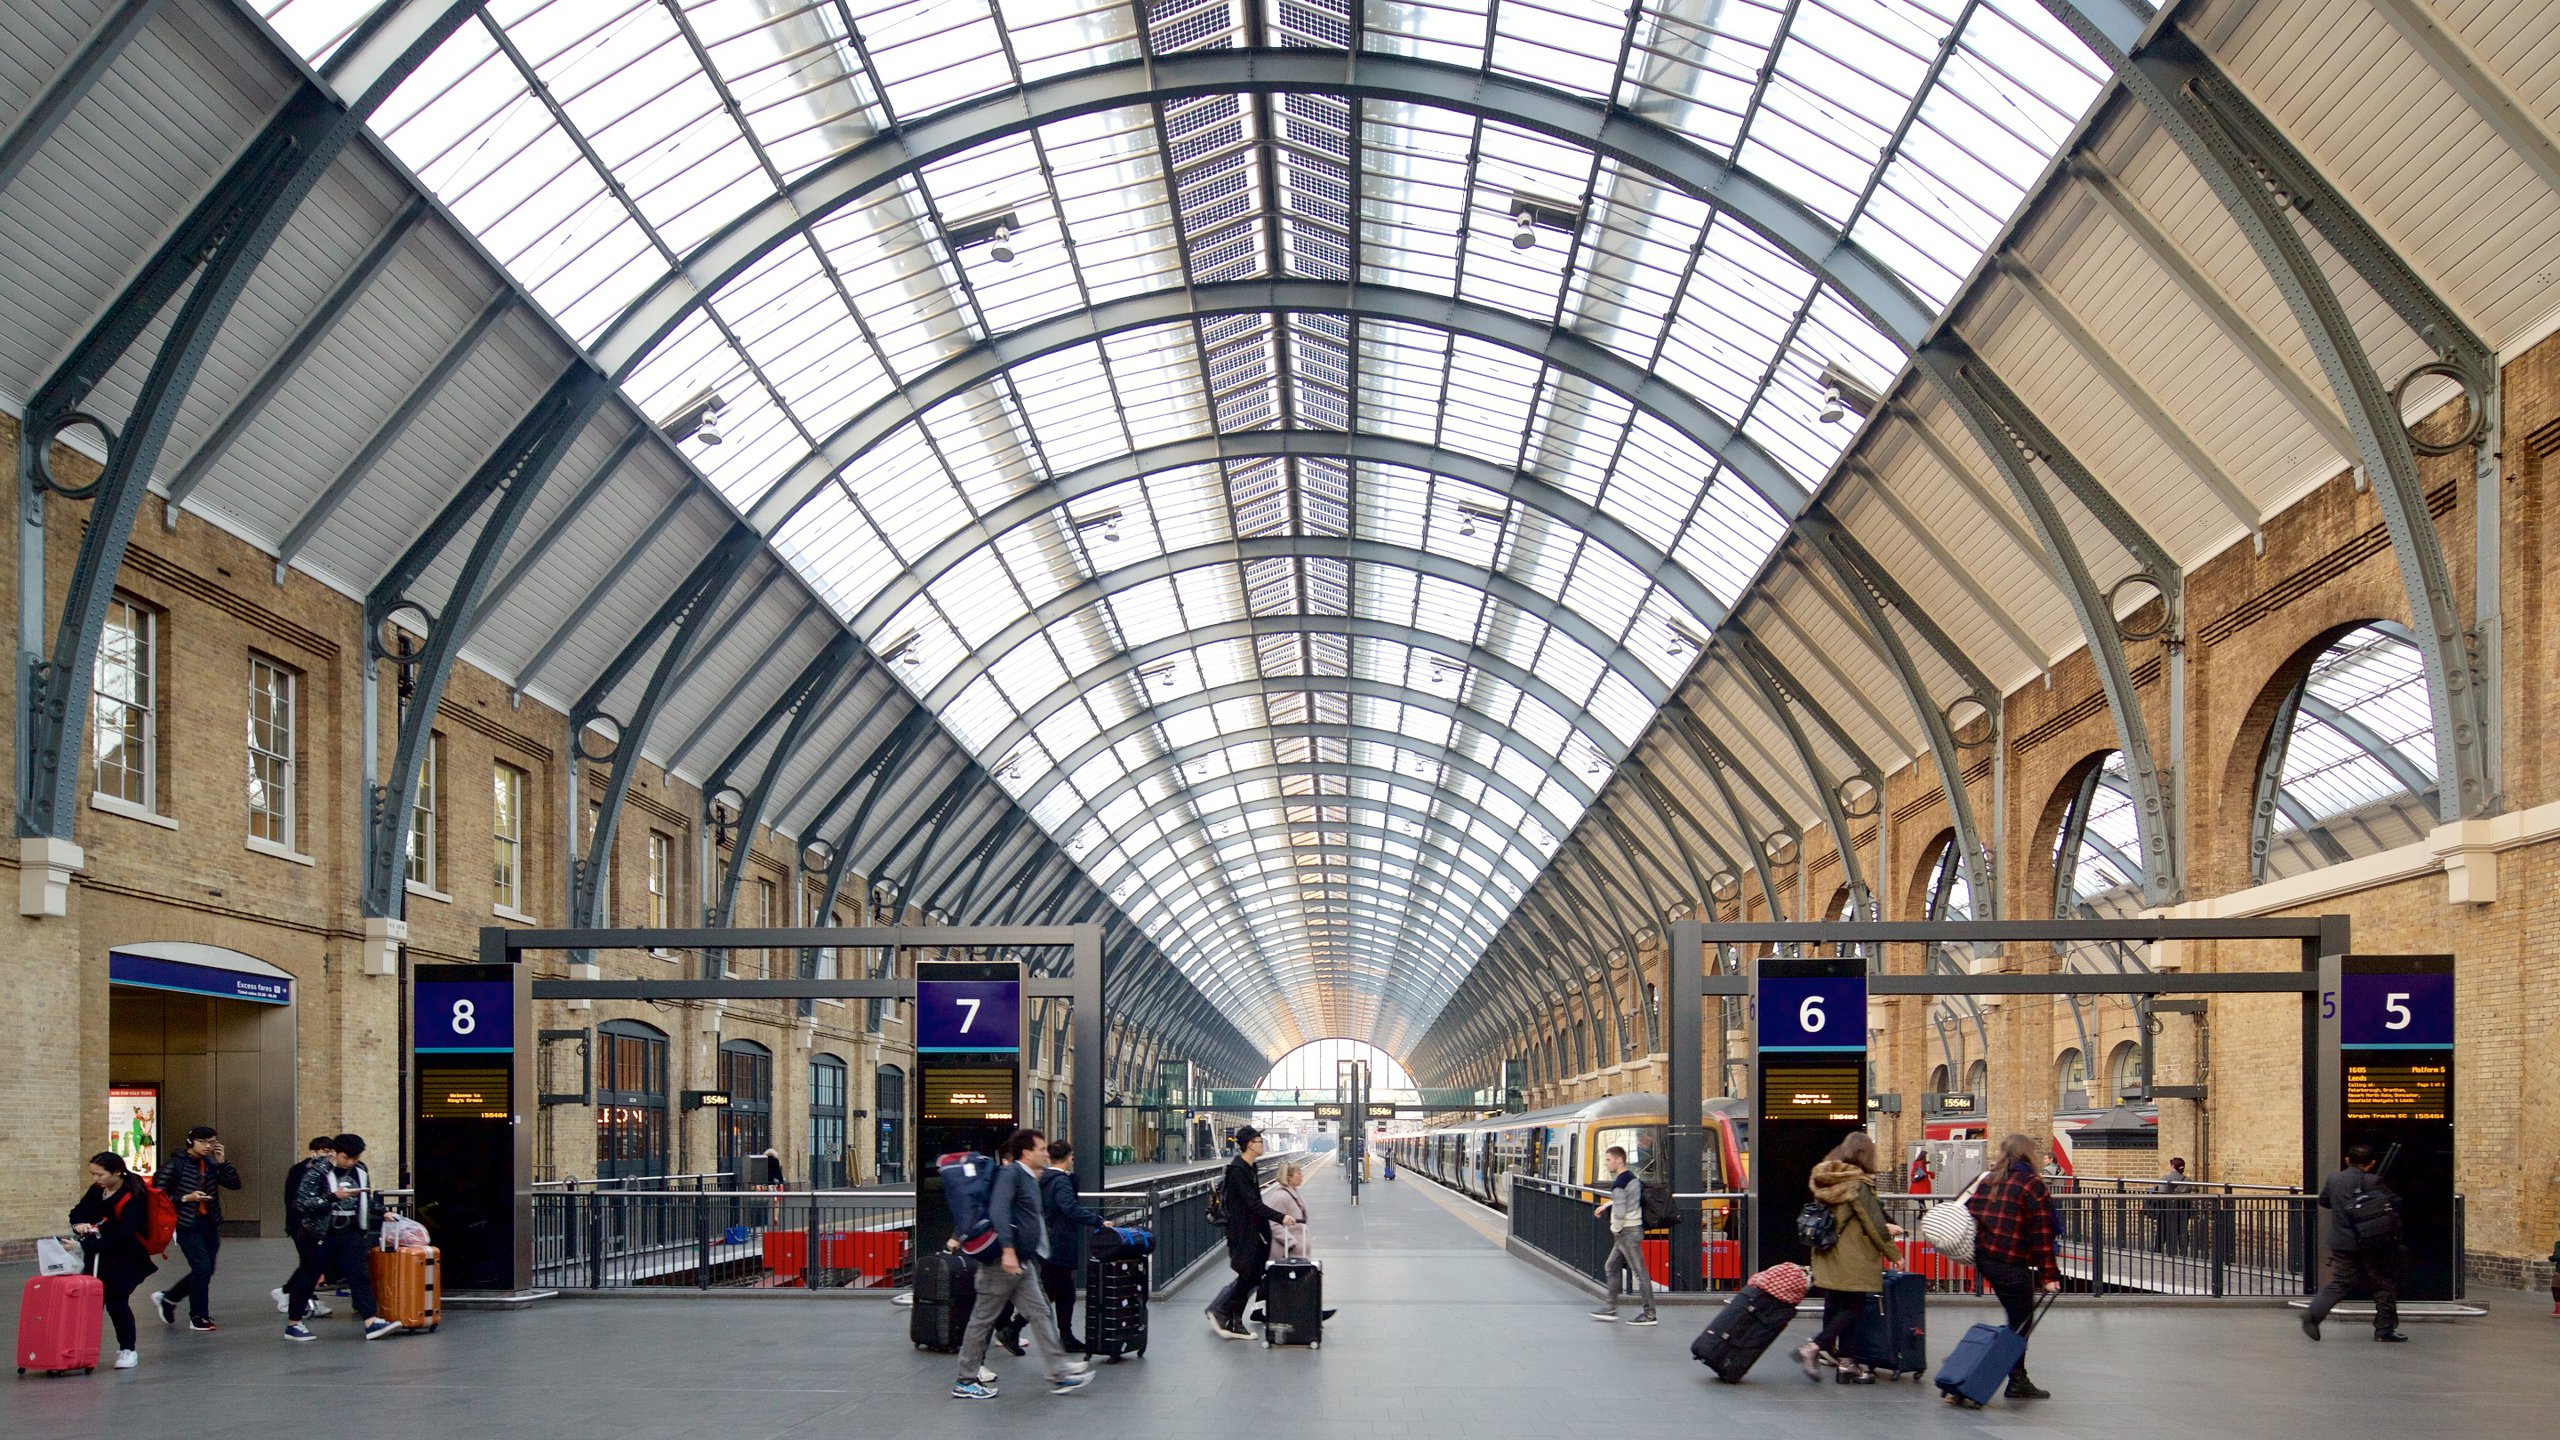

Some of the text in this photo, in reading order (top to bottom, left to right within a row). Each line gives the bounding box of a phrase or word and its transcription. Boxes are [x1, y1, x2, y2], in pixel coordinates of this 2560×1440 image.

[237, 981, 272, 992] Excess fares
[452, 999, 475, 1034] 8
[956, 999, 980, 1033] 7
[1750, 994, 1756, 1020] 6
[1800, 995, 1825, 1032] 6
[2323, 992, 2336, 1019] 5
[2385, 993, 2411, 1030] 5
[597, 1108, 643, 1123] EON
